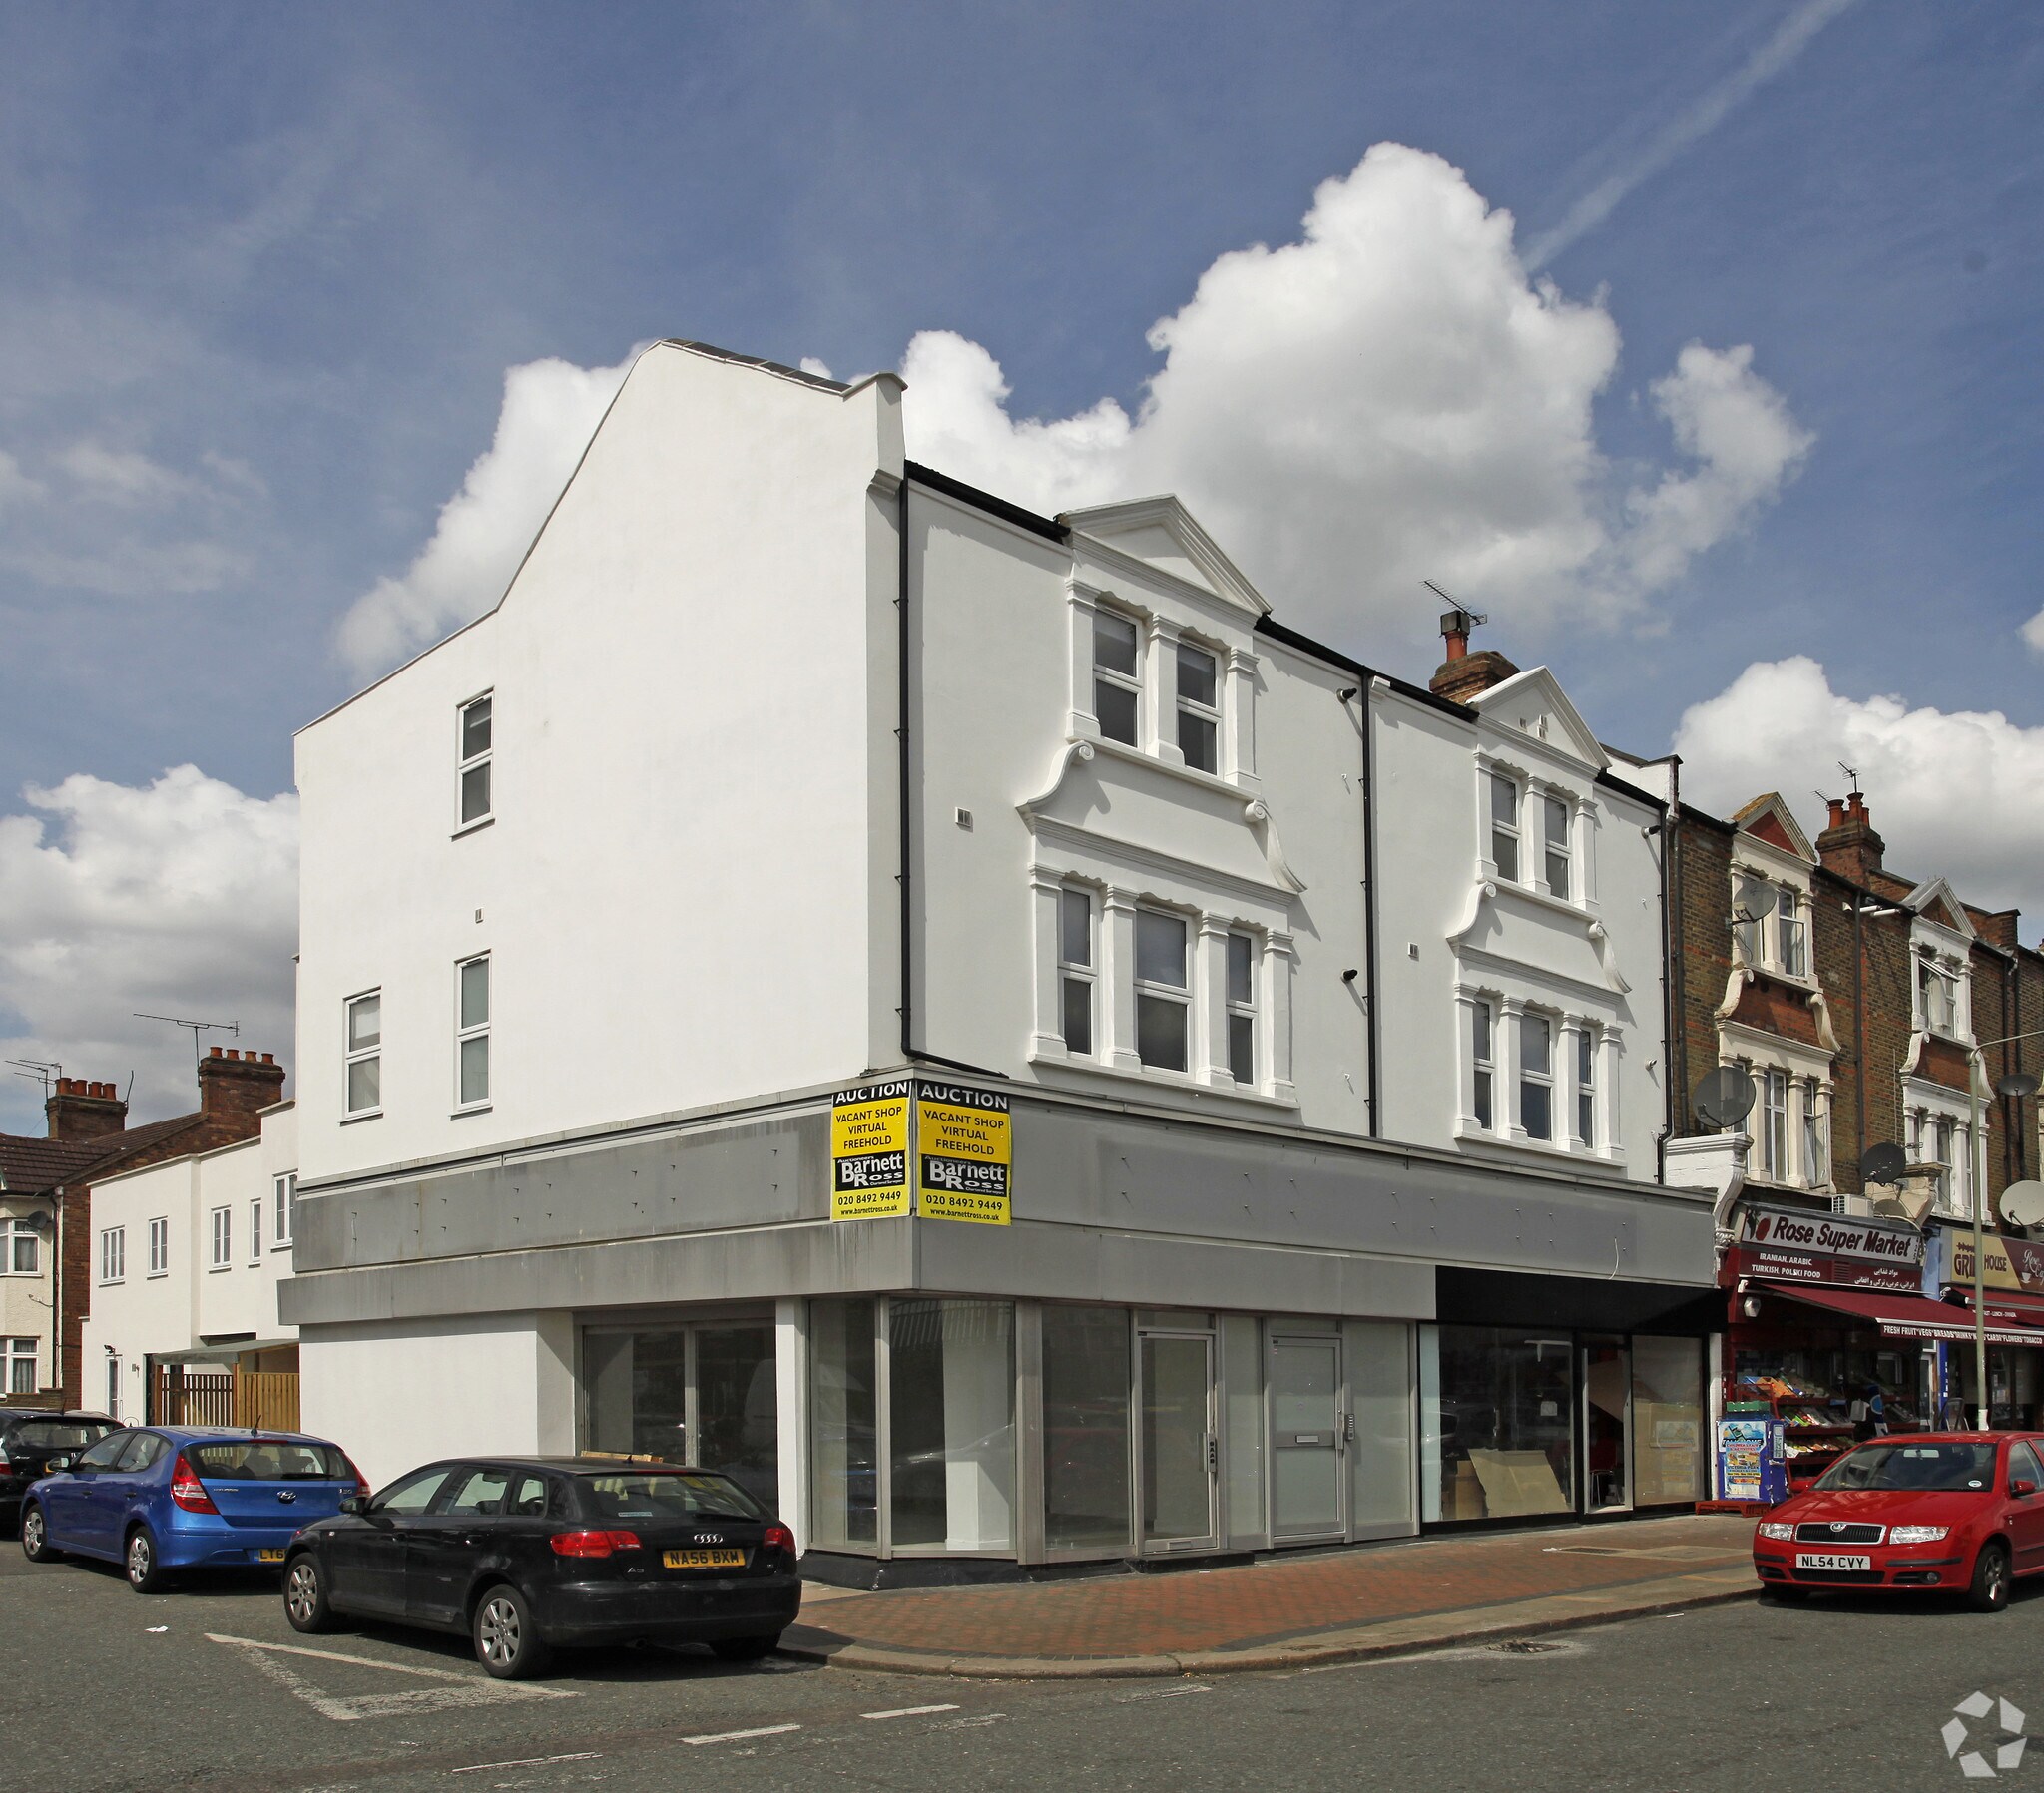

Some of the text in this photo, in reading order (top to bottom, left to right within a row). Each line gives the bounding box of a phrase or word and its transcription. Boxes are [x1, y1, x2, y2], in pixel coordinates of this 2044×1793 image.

[835, 1081, 907, 1104] AUCTION
[921, 1084, 1008, 1110] AUCTION
[836, 1106, 902, 1123] VACANT SHOP
[924, 1110, 1004, 1129] VACANT SHOP
[848, 1122, 887, 1134] VIRTUAL
[941, 1125, 989, 1141] VIRTUAL
[843, 1135, 892, 1149] FREEHOLD
[935, 1139, 995, 1155] FREEHOLD
[841, 1153, 903, 1183] Barnett
[929, 1160, 1005, 1182] Barnett
[854, 1171, 903, 1187] Ross
[945, 1175, 1005, 1190] Ross
[838, 1190, 901, 1205] 020 8492 9449
[926, 1195, 1003, 1210] 020 8492 9449
[841, 1204, 898, 1215] www.barnettross.co.uk
[930, 1208, 1000, 1221] www.barnettross.co.uk
[1773, 1216, 1814, 1243] Rose
[1816, 1223, 1863, 1253] Super
[1863, 1230, 1911, 1256] Market
[1984, 1254, 2007, 1272] HOUSE
[1781, 1267, 1803, 1277] POLSKI
[1883, 1325, 1900, 1334] FRESH
[670, 1551, 739, 1565] NA56 BXM
[1801, 1556, 1864, 1569] NL54 CVY
